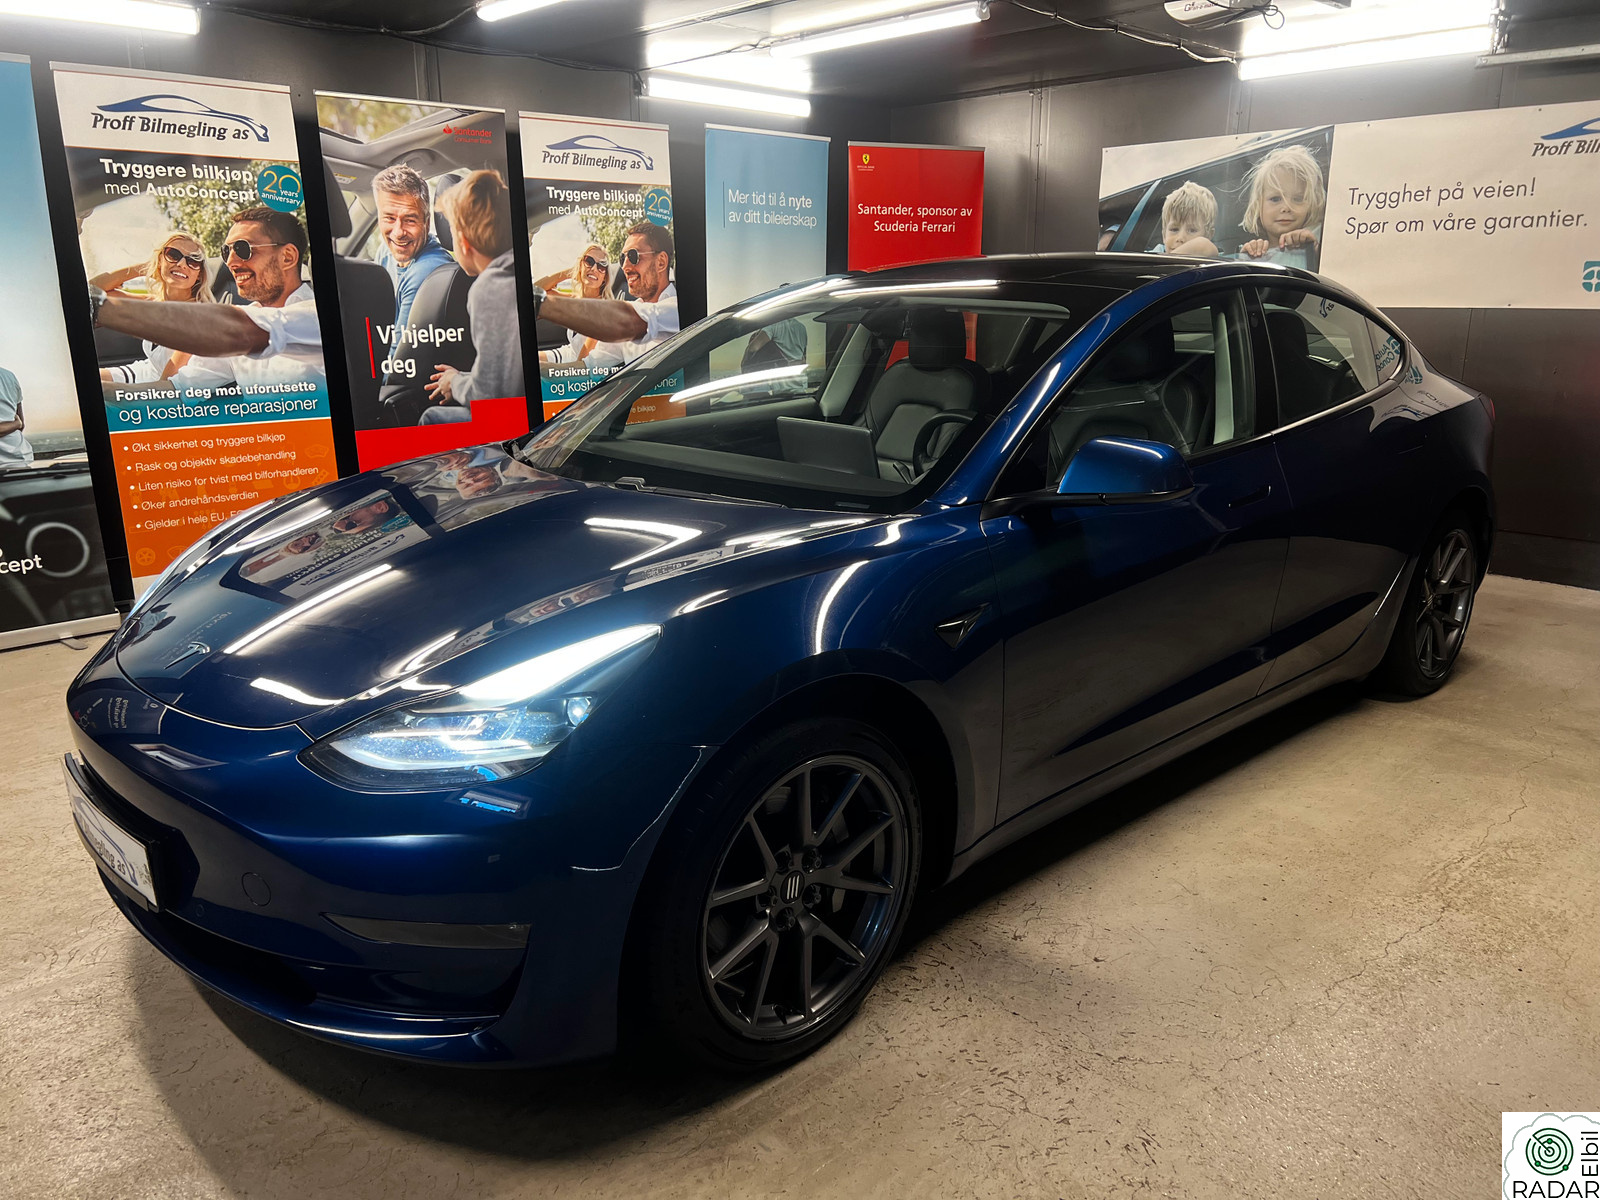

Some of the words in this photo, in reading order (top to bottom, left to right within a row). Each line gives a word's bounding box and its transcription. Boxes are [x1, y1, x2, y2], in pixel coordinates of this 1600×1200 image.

[91, 112, 136, 131] Proff
[138, 116, 228, 140] Bilmegling
[232, 128, 250, 140] as
[453, 127, 492, 137] Santander
[1531, 140, 1574, 157] Proff
[542, 150, 569, 165] Proff
[572, 152, 628, 170] Bilmegling
[628, 159, 642, 170] as
[100, 158, 187, 179] Tryggere
[191, 163, 252, 183] bilkjøp
[104, 181, 141, 196] med
[145, 182, 256, 203] AutoConcept
[261, 192, 301, 206] anniversary
[280, 189, 299, 198] years
[546, 186, 600, 202] Tryggere
[603, 189, 643, 205] bilkjøp
[728, 189, 749, 205] Mer
[751, 190, 766, 206] tid
[768, 192, 778, 207] til
[779, 192, 787, 207] å
[788, 195, 813, 210] nyte
[1348, 183, 1432, 210] Trygghet
[1437, 181, 1464, 207] på
[1473, 177, 1536, 200] veien!
[548, 205, 571, 215] med
[574, 205, 643, 219] AutoConcept
[728, 213, 742, 223] av
[743, 209, 762, 224] ditt
[763, 211, 818, 229] bileierskap
[858, 203, 914, 217] Santander,
[917, 206, 958, 219] sponsor
[961, 207, 973, 217] av
[874, 220, 919, 233] Scuderia
[921, 221, 956, 233] Ferrari
[1345, 217, 1389, 239] Spør
[1395, 218, 1424, 233] om
[1433, 212, 1476, 232] våre
[1483, 209, 1588, 235] garantier.
[376, 325, 397, 345] Vi
[401, 323, 465, 348] hjelper
[380, 358, 417, 377] deg
[548, 367, 590, 377] Forsikrer
[592, 366, 609, 375] deg
[115, 388, 181, 402] Forsikrer
[185, 386, 212, 400] deg
[215, 384, 243, 397] mot
[245, 381, 317, 395] uforutsette
[550, 383, 565, 395] og
[119, 408, 142, 425] og
[146, 402, 220, 422] kostbare
[224, 397, 319, 418] reparasjoner
[132, 442, 152, 453] Økt
[153, 440, 198, 451] sikkerhet
[200, 439, 214, 449] og
[216, 435, 255, 447] tryggere
[256, 433, 286, 443] bilkjøp
[135, 462, 162, 472] Rask
[164, 461, 178, 471] og
[179, 457, 217, 470] objektiv
[219, 450, 296, 465] skadebehandling
[138, 481, 164, 492] Liten
[165, 478, 192, 489] risiko
[194, 476, 207, 486] for
[209, 474, 230, 484] tvist
[231, 471, 253, 482] med
[254, 465, 319, 480] bilforhandleren
[141, 500, 166, 511] Øker
[169, 491, 259, 507] andrehåndsverdien
[144, 518, 179, 531] Gjelder
[187, 514, 209, 525] hele
[210, 511, 228, 522] EU,
